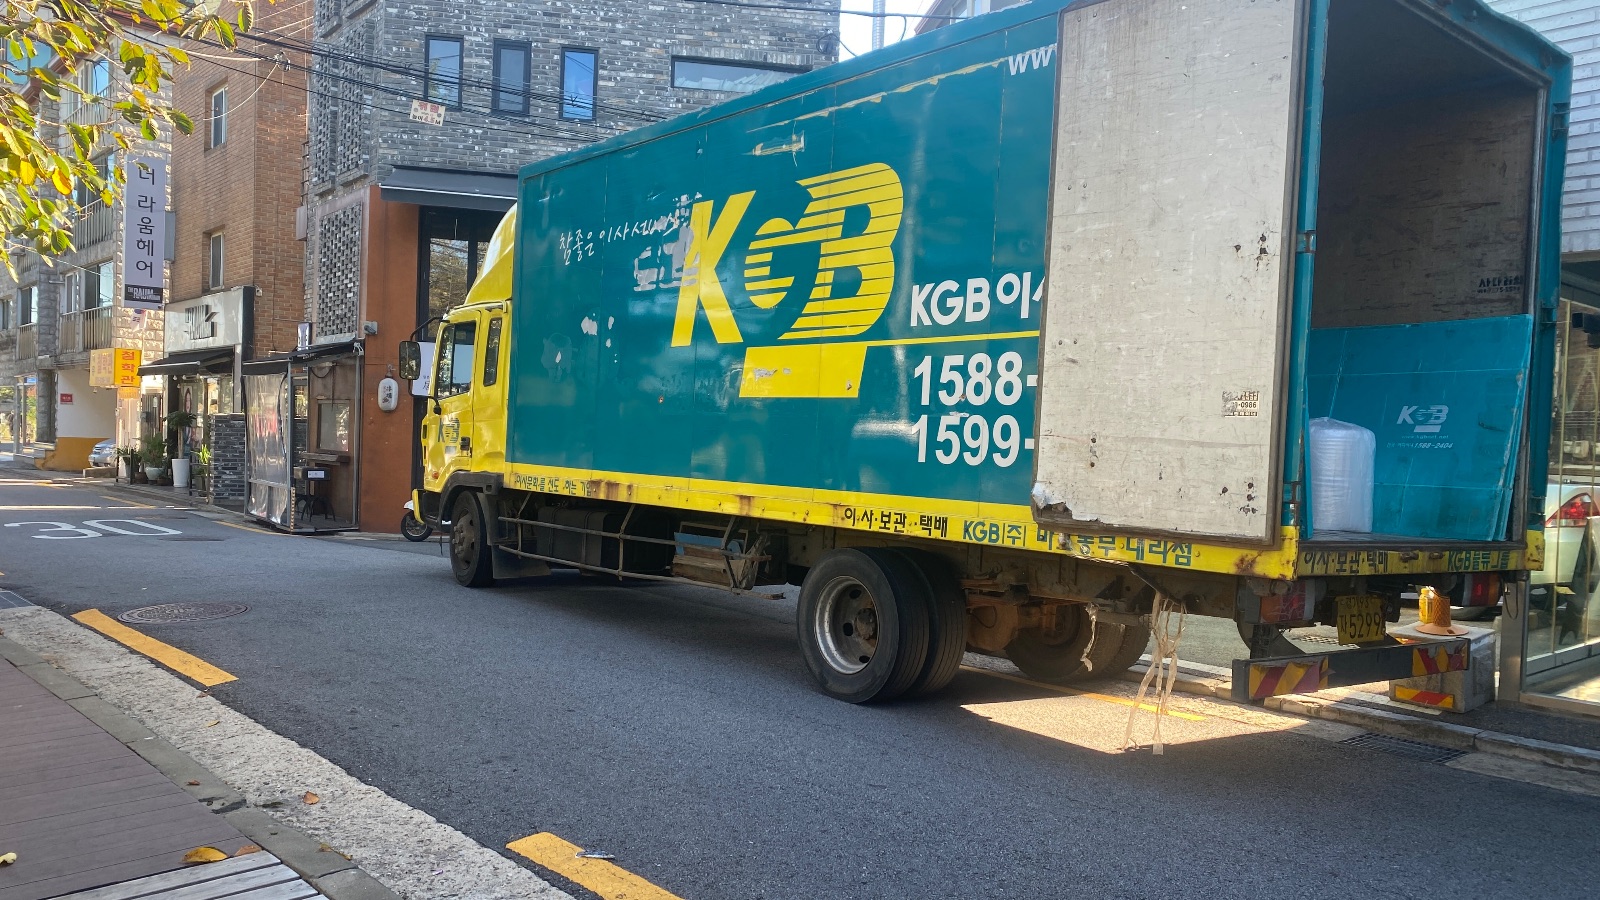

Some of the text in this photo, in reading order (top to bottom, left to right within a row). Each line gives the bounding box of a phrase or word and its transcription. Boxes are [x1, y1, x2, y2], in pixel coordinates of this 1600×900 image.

[671, 162, 904, 348] KGB
[1396, 404, 1449, 425] KGB
[4, 519, 182, 539] 30
